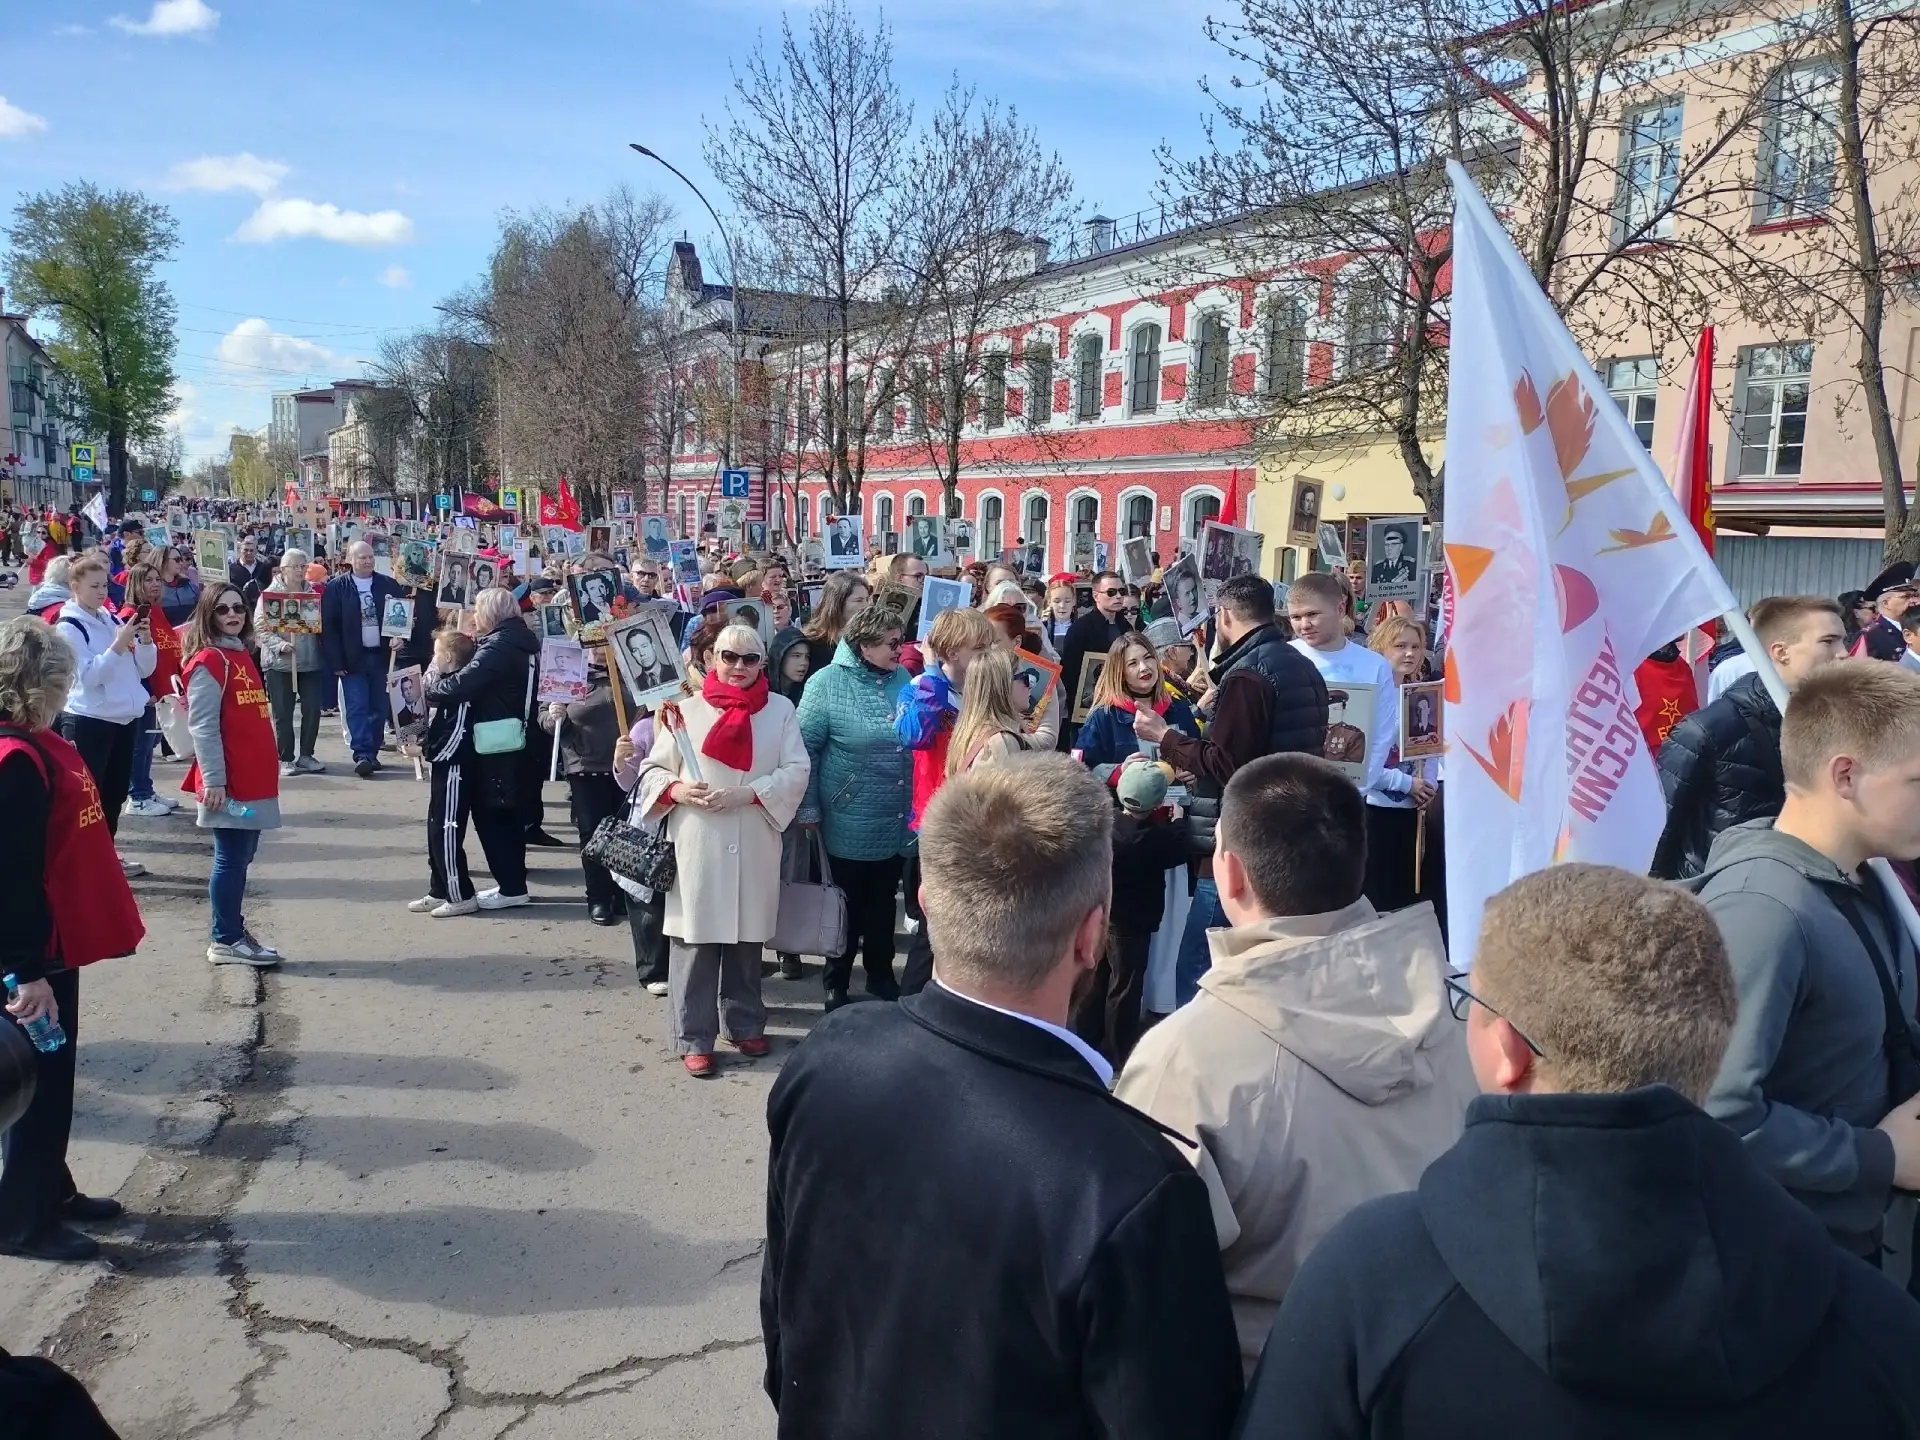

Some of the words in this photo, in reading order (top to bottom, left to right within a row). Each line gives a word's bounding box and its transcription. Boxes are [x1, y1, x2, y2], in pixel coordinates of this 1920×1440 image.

[80, 468, 89, 479] P
[730, 474, 745, 494] P
[440, 496, 448, 507] P
